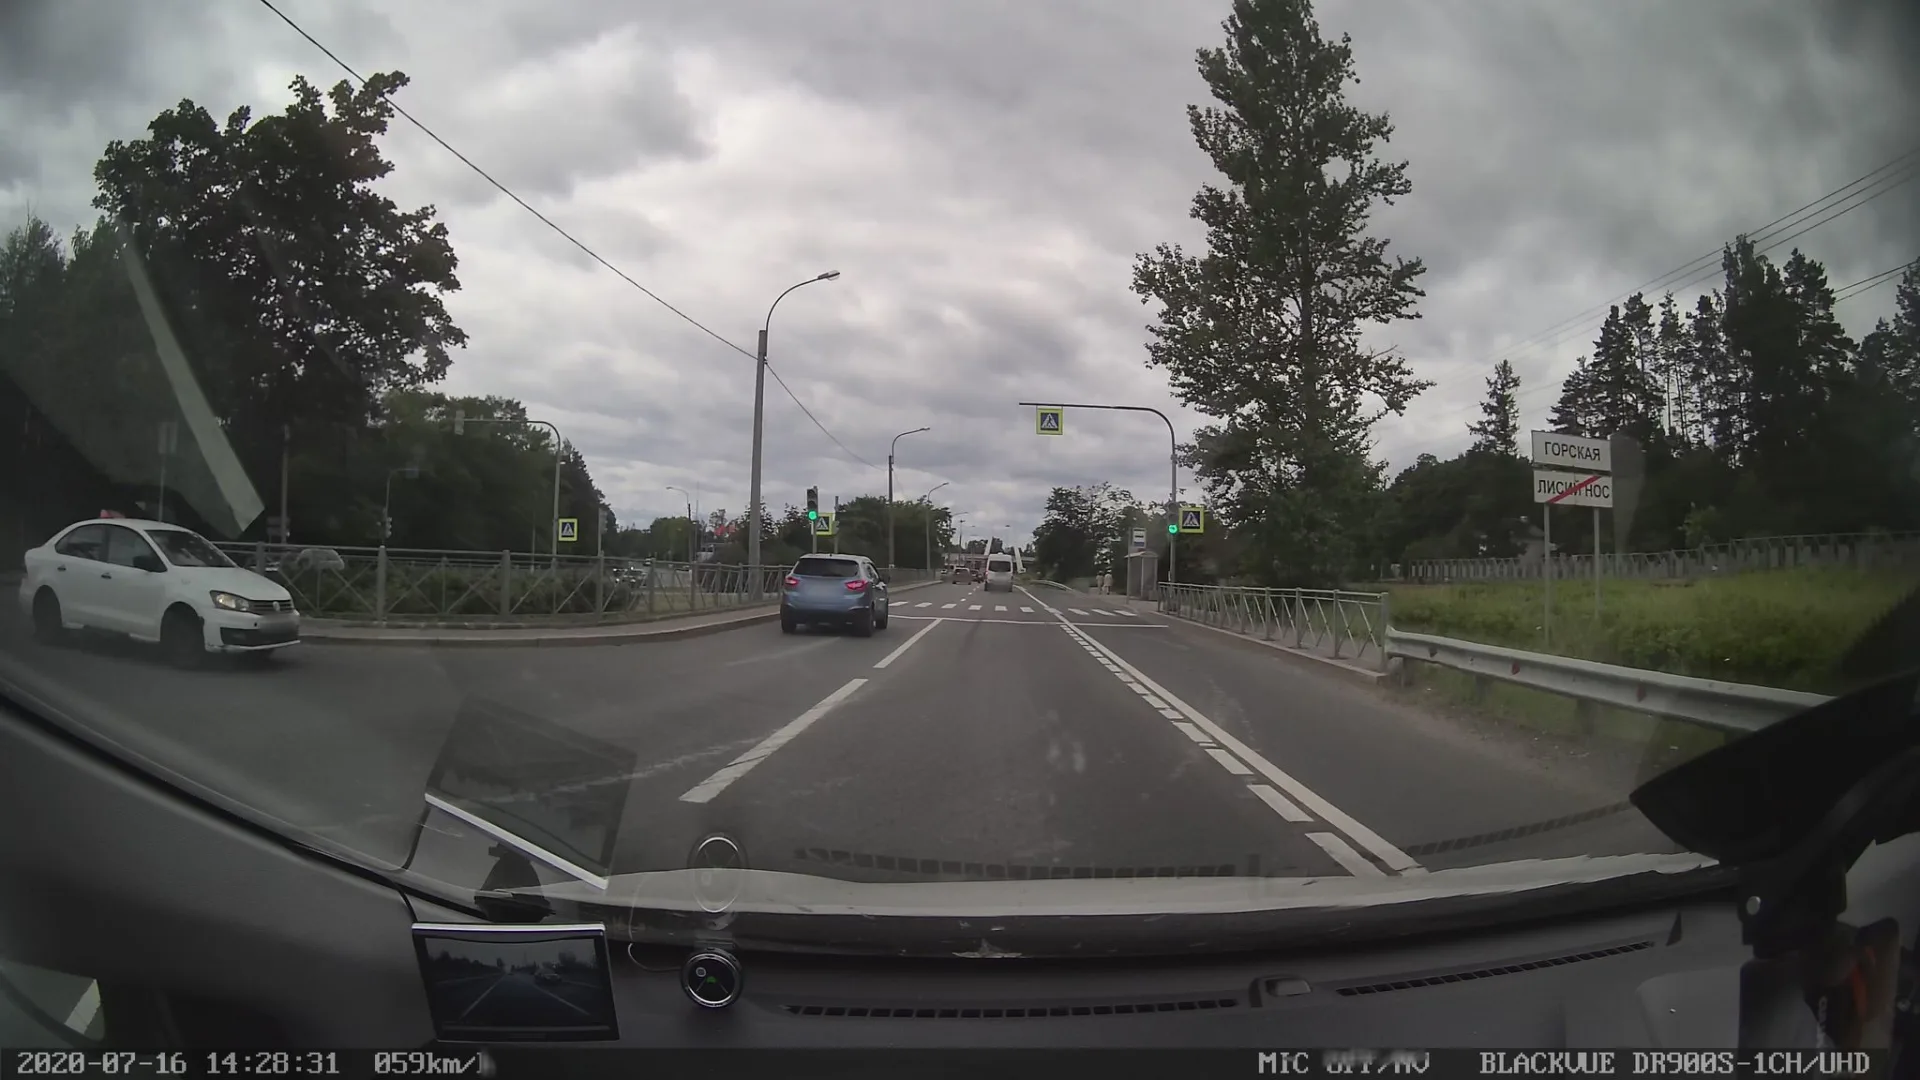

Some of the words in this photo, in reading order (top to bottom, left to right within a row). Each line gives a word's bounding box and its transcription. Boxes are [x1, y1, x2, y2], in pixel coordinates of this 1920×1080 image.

[1544, 441, 1601, 461] ГОРСКАЯ
[1537, 479, 1583, 497] ЛИСИЙ
[1585, 484, 1610, 499] НОС
